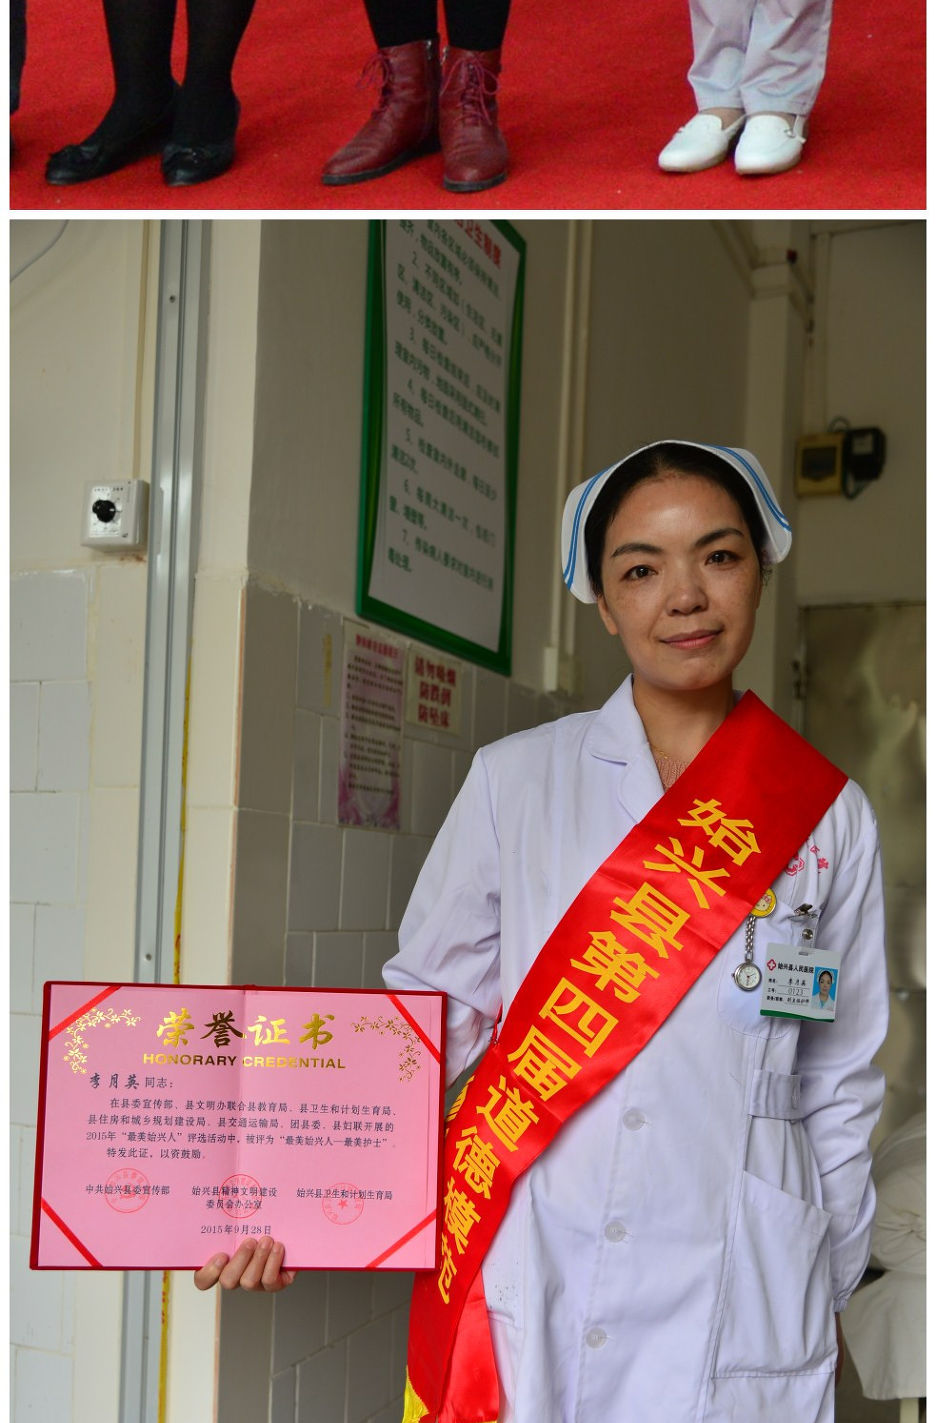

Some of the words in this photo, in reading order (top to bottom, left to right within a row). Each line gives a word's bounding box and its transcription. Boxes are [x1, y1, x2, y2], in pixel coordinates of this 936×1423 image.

[455, 220, 502, 270] 卫生制度
[156, 1007, 335, 1051] 荣誉证书
[143, 1053, 237, 1066] HONORARY
[243, 1056, 346, 1069] CREDENTIAL
[437, 798, 761, 1304] 始兴县第四届道德模范
[296, 1187, 393, 1201] 始兴县卫生和计划生育局
[201, 1225, 272, 1236] 2015年9月28日
